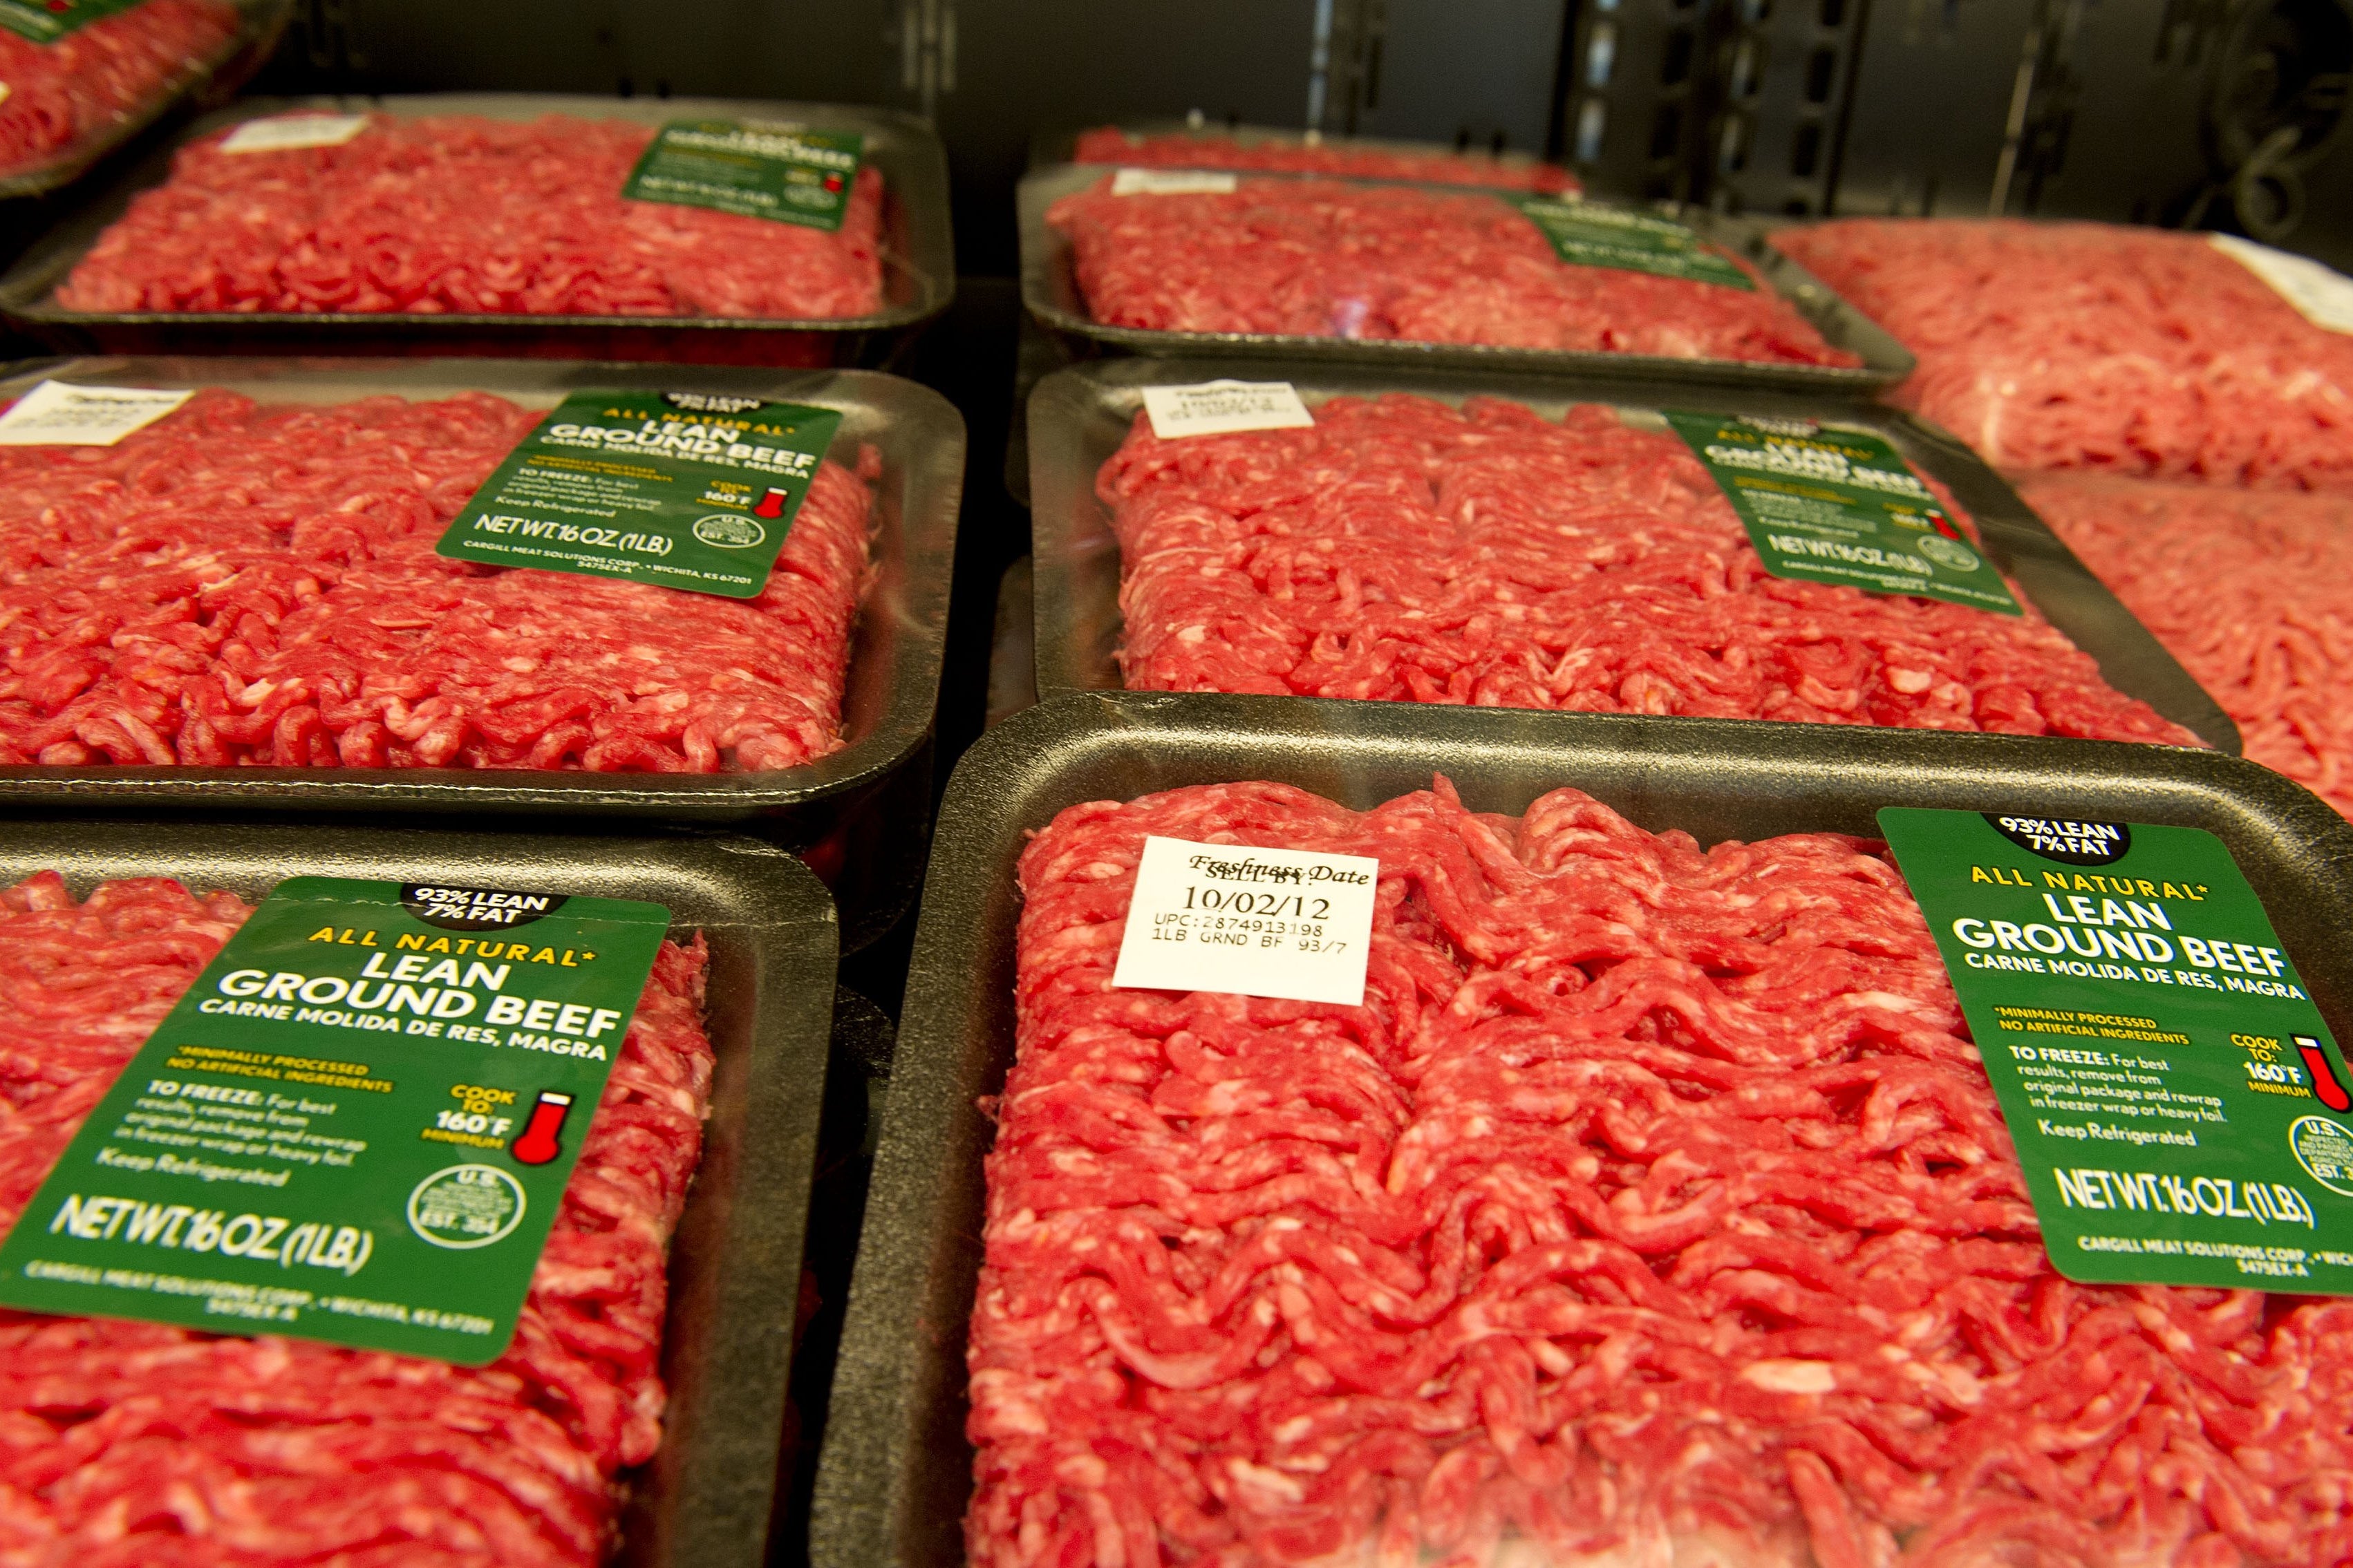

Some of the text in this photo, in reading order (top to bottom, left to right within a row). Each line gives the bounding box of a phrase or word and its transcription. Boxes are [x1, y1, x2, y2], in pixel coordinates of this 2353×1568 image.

[603, 408, 648, 420] ALL
[642, 419, 740, 444] LEAN
[550, 424, 816, 469] GROUND BEEF
[743, 460, 809, 479] MAGRA
[474, 514, 525, 534] NET
[557, 525, 579, 542] 16
[463, 540, 509, 552] CARGILL
[512, 546, 543, 556] MEAT
[543, 550, 607, 564] SOLUTIONS
[702, 572, 718, 580] KS
[1998, 816, 2123, 841] 93% LEAN
[2027, 834, 2113, 856] 7% FAT
[1308, 865, 1369, 885] Date
[1971, 865, 2034, 887] ALL
[414, 887, 549, 911] 93% LEAN
[1182, 885, 1330, 920] 10/02/12
[423, 903, 522, 923] 7% FAT
[2041, 893, 2175, 931] LEAN
[309, 927, 378, 947] ALL
[1152, 928, 1347, 954] 1LB GRND BF 93/7
[1951, 918, 2288, 979] GROUND BEEF
[362, 952, 512, 991] LEAN
[1964, 952, 2307, 1001] CARNE MOLIDA DE RES, MAGRA
[219, 969, 622, 1039] GROUND BEEF
[199, 999, 608, 1061] CARNE MOLIDA DE RES, MAGRA
[1999, 1020, 2190, 1046] NO ARTIFICIAL INGREDIENTS
[2077, 1012, 2157, 1030] PROCESSED
[2230, 1033, 2282, 1051] COOK
[273, 1055, 369, 1077] PROCESSED
[2008, 1046, 2171, 1071] TO FREEZE: For best
[2247, 1048, 2278, 1063] TO:
[147, 1079, 180, 1095] TO
[167, 1057, 195, 1069] NO
[284, 1070, 394, 1093] INGREDIENTS
[2016, 1064, 2162, 1086] results, remove from
[451, 1084, 517, 1105] COOK
[2023, 1079, 2224, 1108] original package and rewrap
[2247, 1081, 2312, 1098] MINIMUM
[2029, 1095, 2045, 1108] in
[2045, 1095, 2100, 1113] freezer
[2101, 1103, 2140, 1117] wrap
[2140, 1105, 2158, 1117] or
[2155, 1104, 2201, 1122] heavy
[2037, 1118, 2199, 1146] Keep Refrigerated
[2304, 1120, 2341, 1137] U.S.
[95, 1146, 292, 1187] Keep Refrigerated
[2053, 1166, 2116, 1209] NET
[2159, 1174, 2198, 1215] 16
[48, 1193, 138, 1240] NET
[182, 1209, 226, 1252] 16
[2077, 1235, 2144, 1254] CARGILL
[2142, 1238, 2183, 1254] MEAT
[2184, 1240, 2266, 1261] SOLUTIONS
